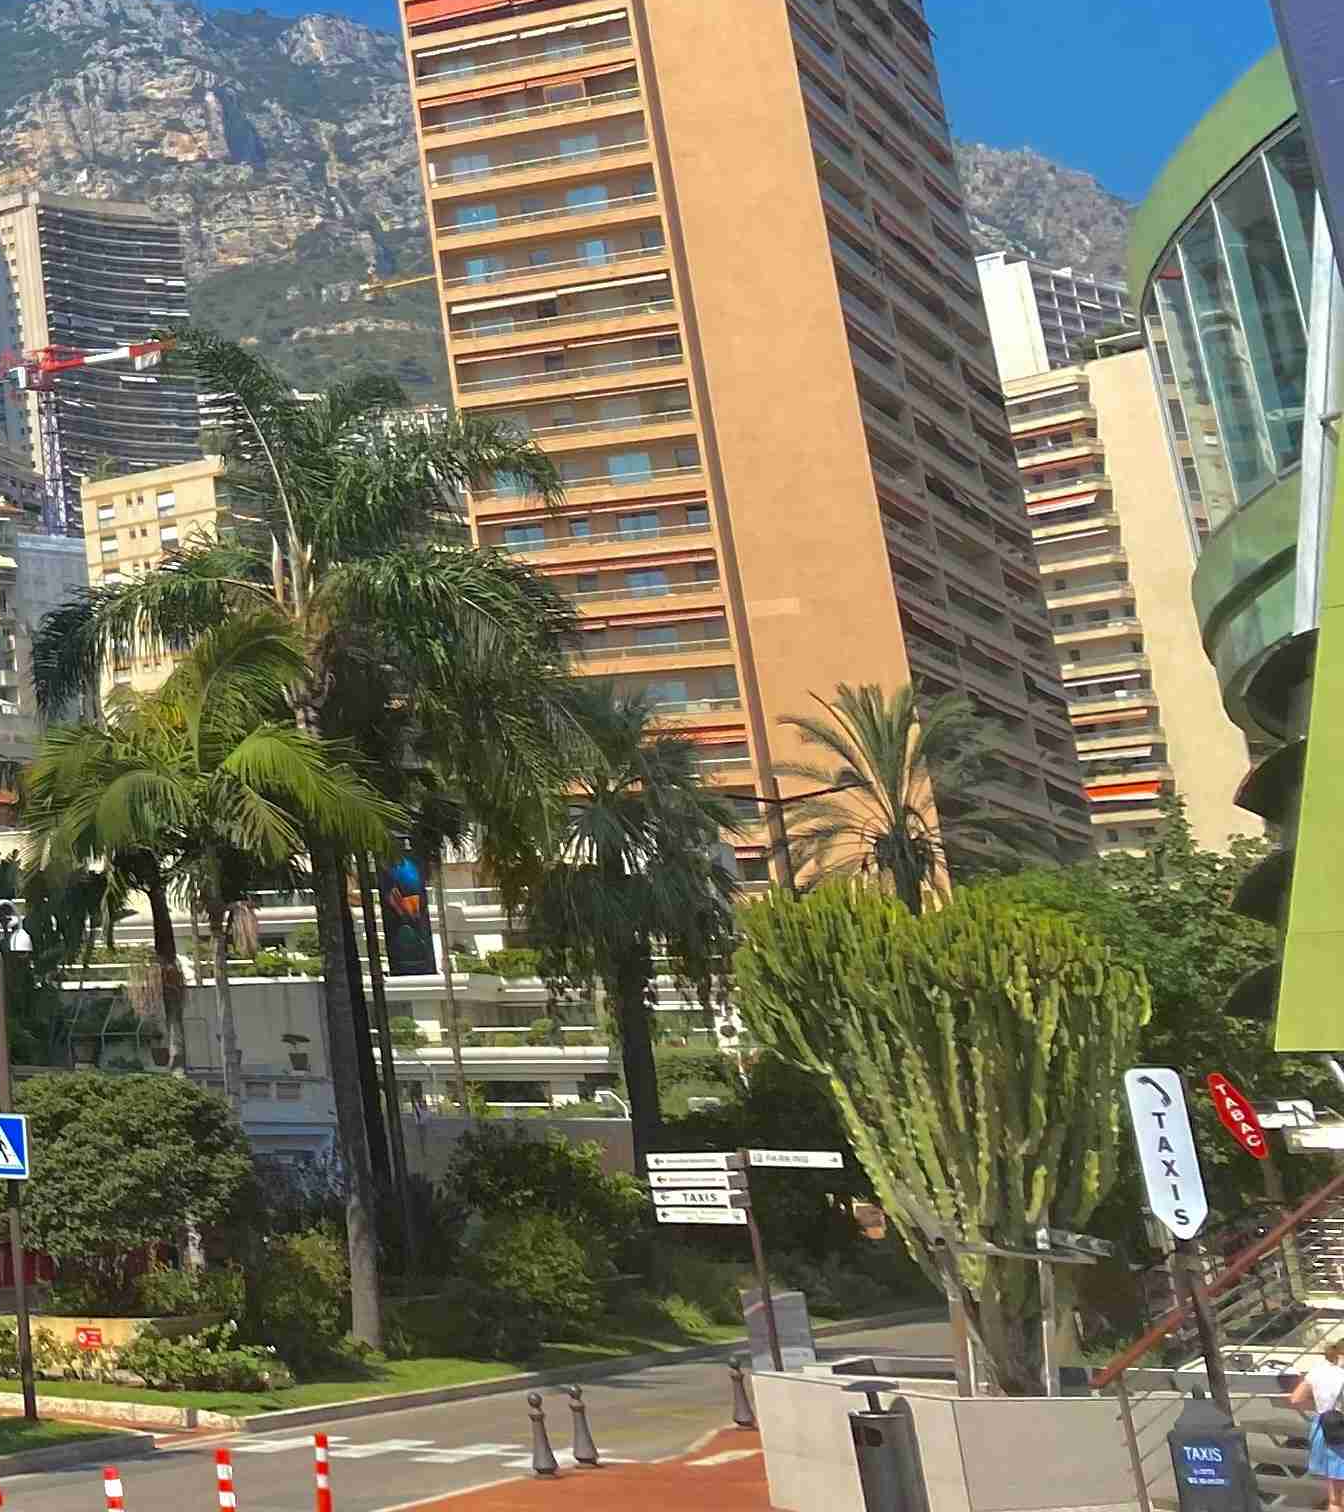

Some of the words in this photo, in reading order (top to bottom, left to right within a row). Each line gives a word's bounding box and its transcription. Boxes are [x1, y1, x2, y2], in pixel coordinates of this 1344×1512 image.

[1215, 1083, 1262, 1148] TABAC
[1152, 1112, 1190, 1226] TAXIS
[681, 1192, 719, 1203] TAXIS
[1183, 1446, 1223, 1462] TAXIS
